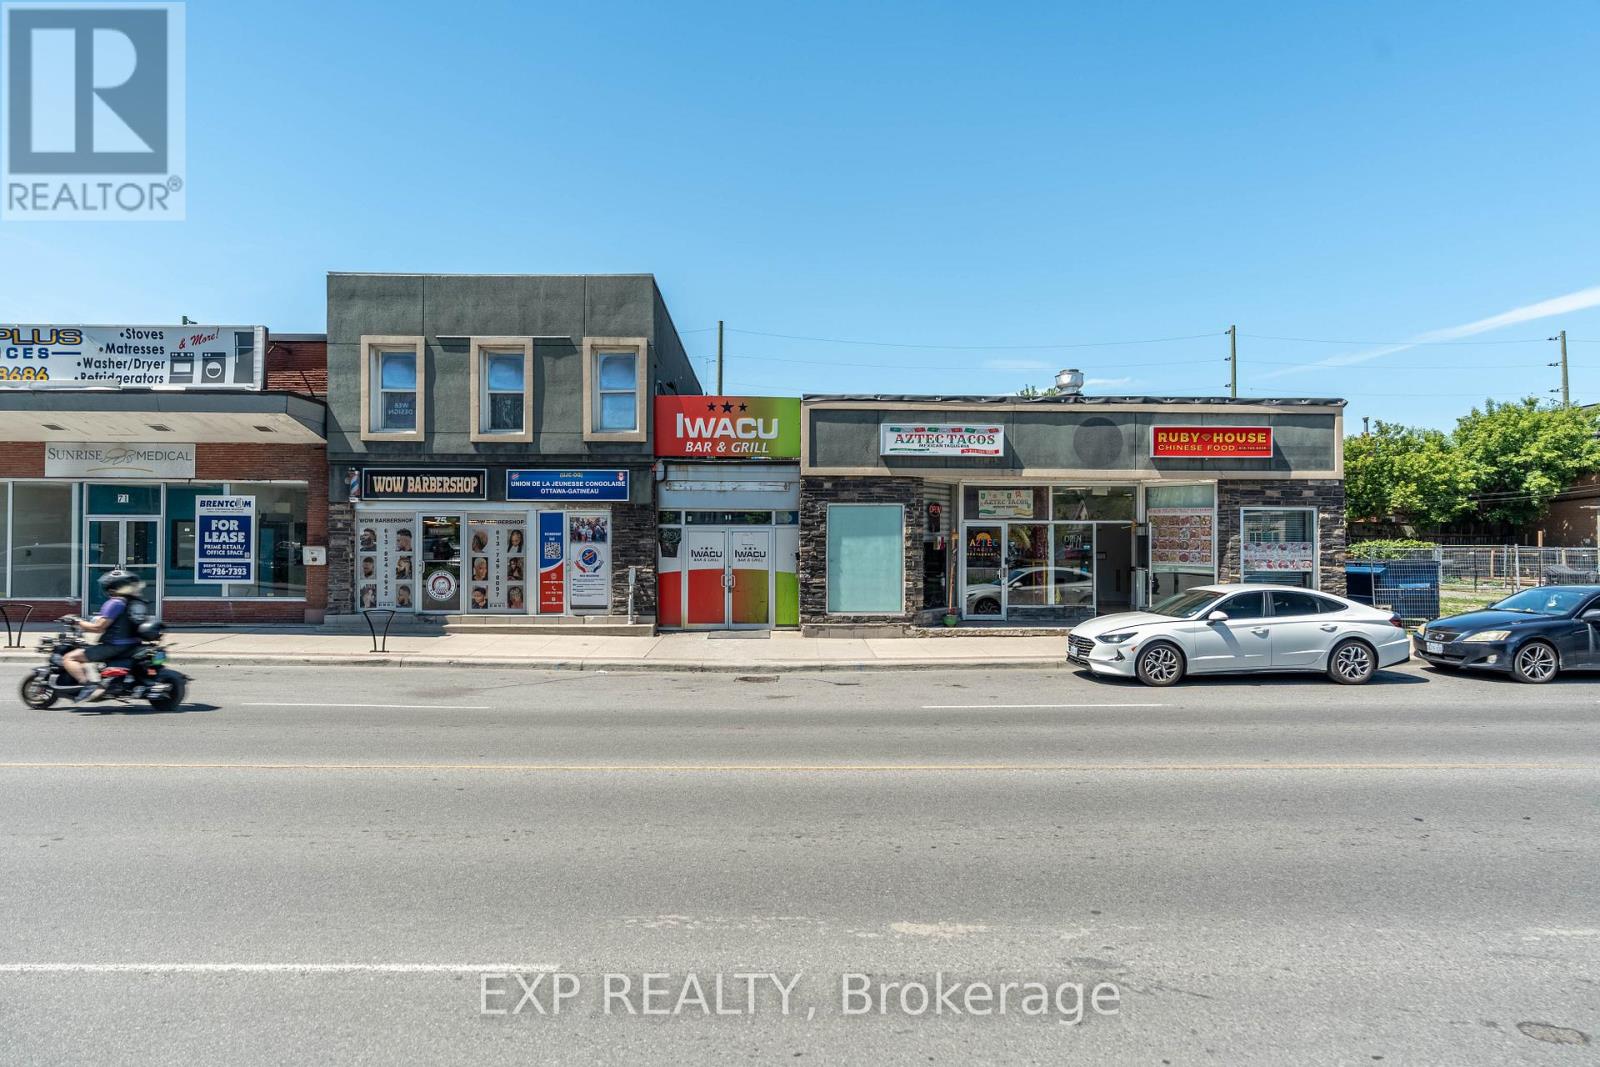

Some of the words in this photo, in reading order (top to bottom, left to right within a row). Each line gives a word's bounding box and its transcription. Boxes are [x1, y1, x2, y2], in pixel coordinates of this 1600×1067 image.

[125, 328, 164, 340] Stoves
[178, 339, 186, 350] &
[191, 327, 220, 346] More!
[0, 347, 49, 359] CES
[105, 343, 165, 355] Matresses
[83, 357, 165, 372] Washer/Dryer
[676, 413, 779, 439] IWACU
[895, 434, 944, 444] AZTEC
[946, 434, 995, 445] TACOS
[1158, 432, 1200, 443] RUBY
[1213, 432, 1266, 443] HOUSE
[47, 447, 103, 461] SUNRISE
[136, 451, 193, 461] MEDICAL
[685, 442, 712, 453] BAR
[716, 442, 727, 453] &
[731, 442, 769, 454] GRILL
[373, 476, 405, 493] WOW
[407, 476, 478, 493] BARBERSHOP
[211, 520, 239, 531] FOR
[204, 532, 246, 543] LEASE
[969, 538, 999, 547] AZTEC
[691, 549, 723, 558] IWACU
[734, 549, 767, 558] IWACU
